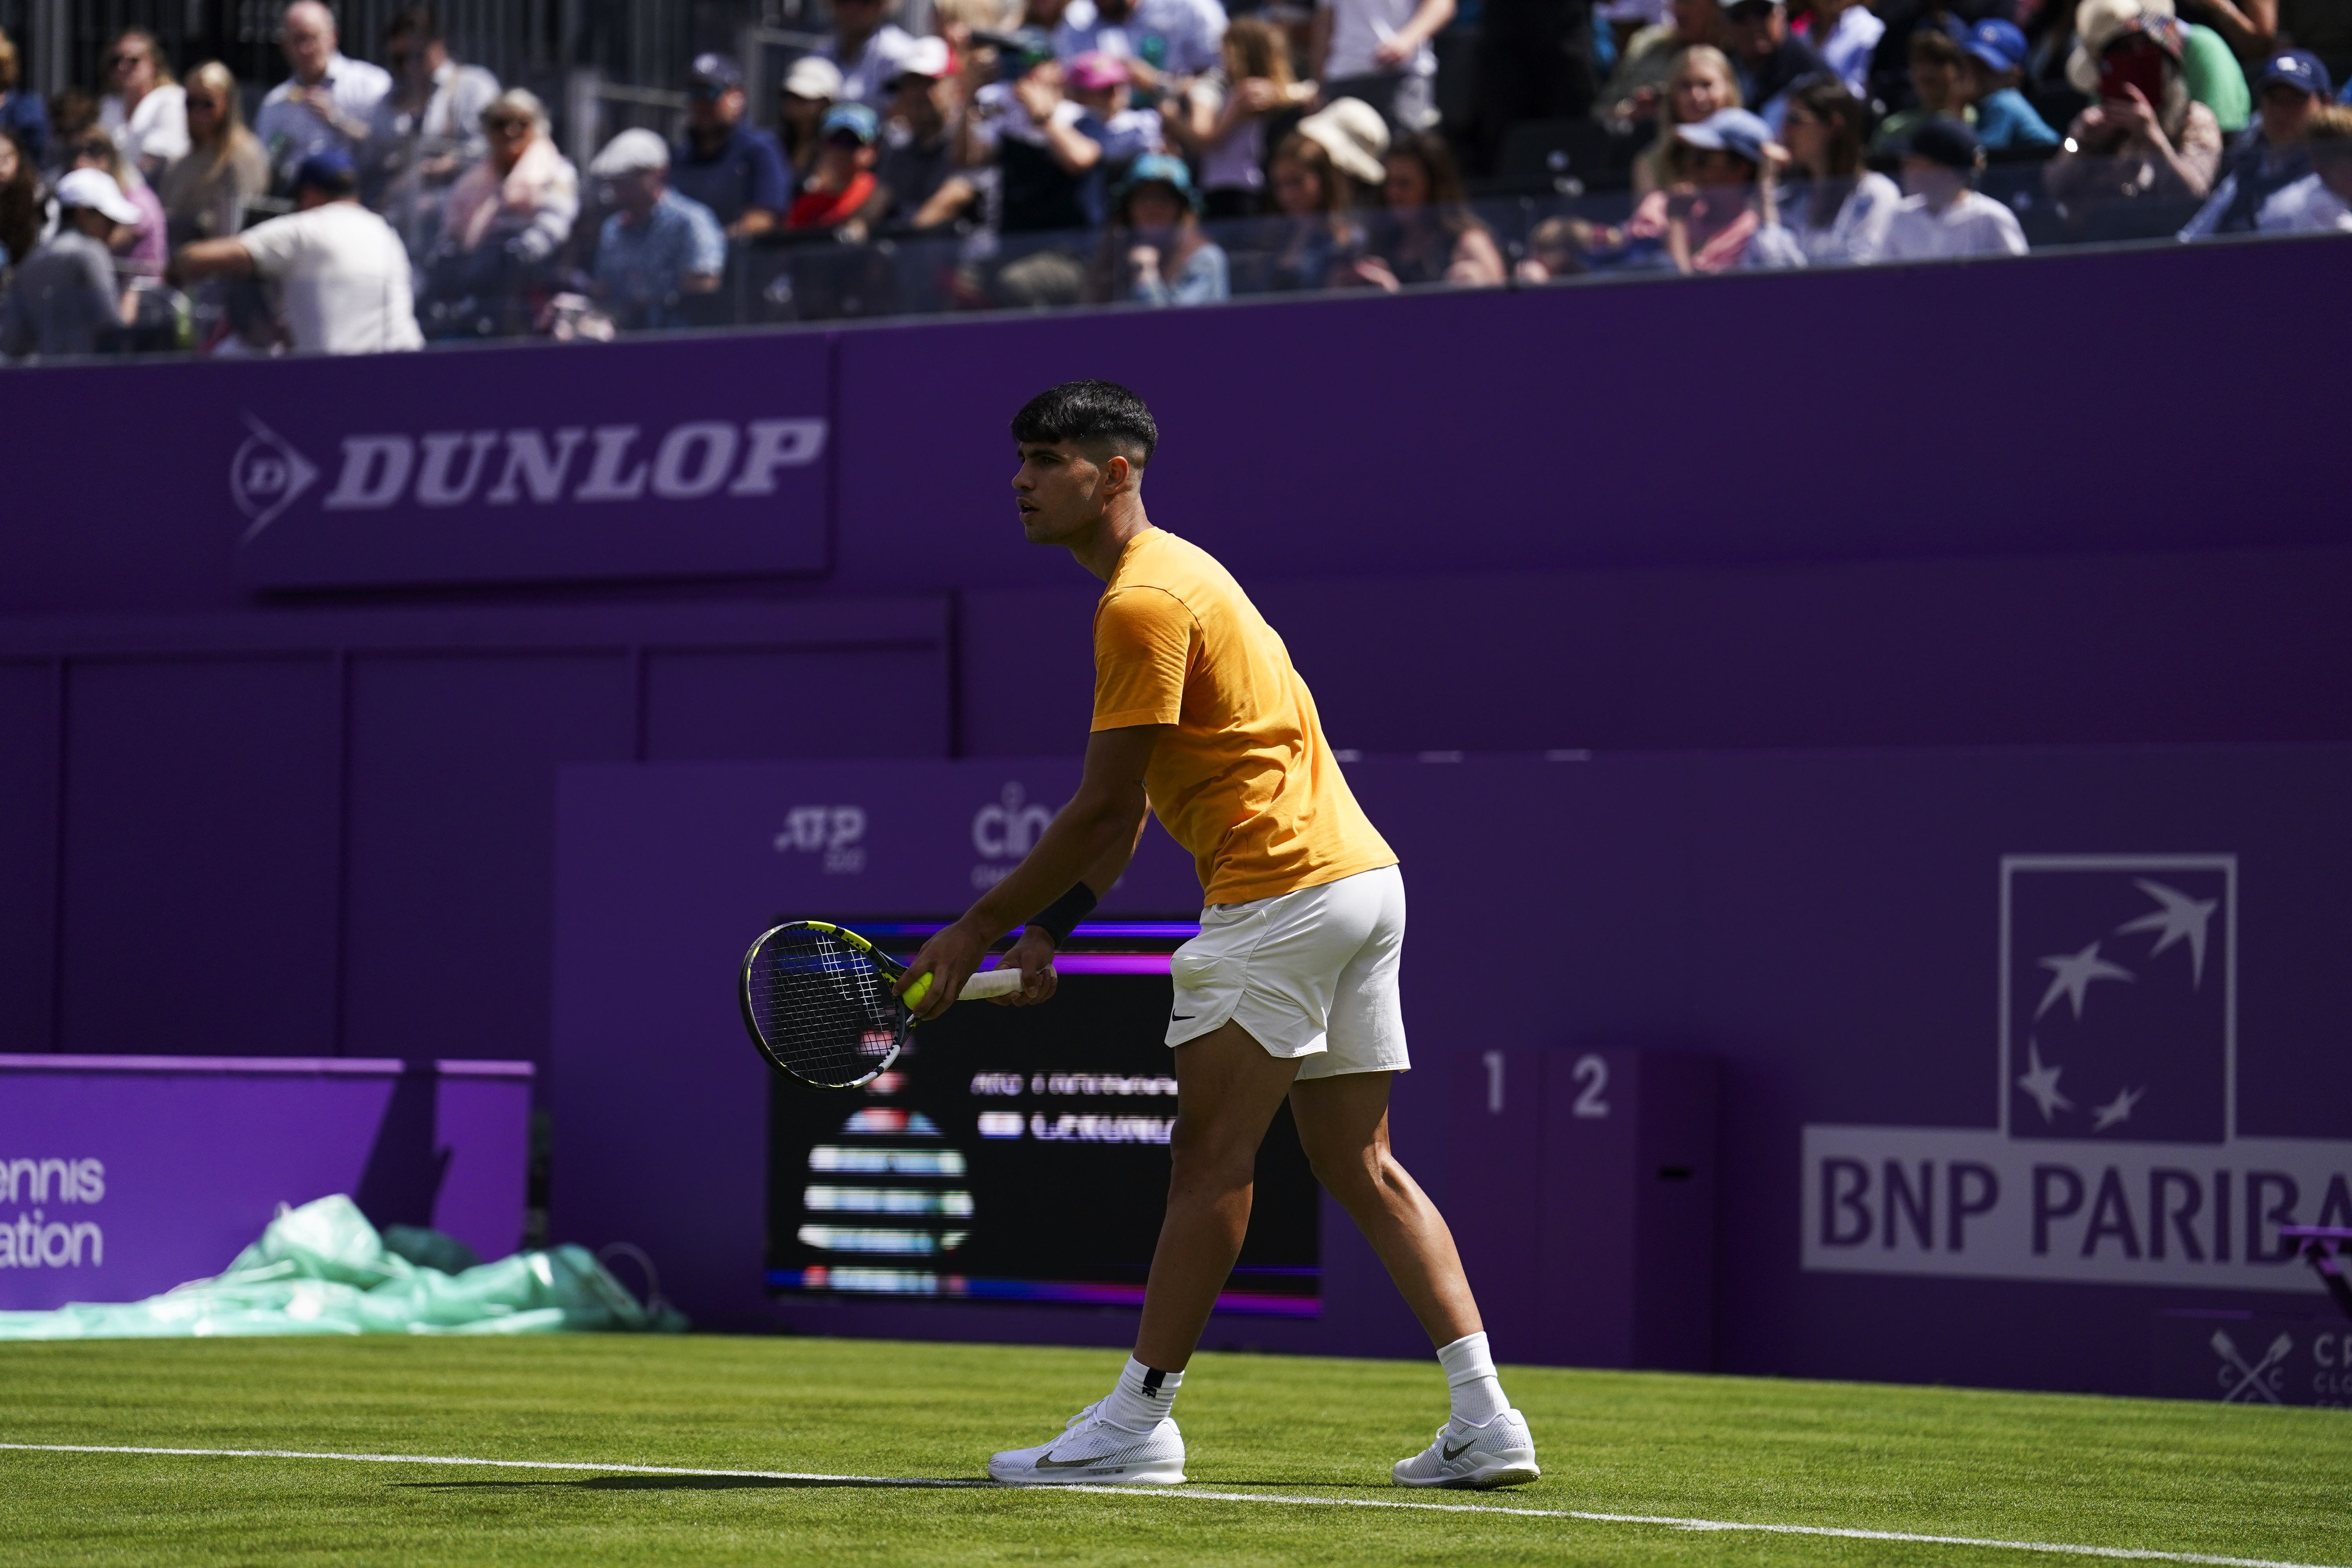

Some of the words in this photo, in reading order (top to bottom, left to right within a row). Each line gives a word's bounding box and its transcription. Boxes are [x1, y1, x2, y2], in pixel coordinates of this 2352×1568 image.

[322, 417, 828, 510] DUNLOP
[774, 806, 866, 852] ATP
[1483, 1051, 1504, 1113] 1
[1572, 1054, 1609, 1118] 2
[1820, 1156, 1999, 1252] BNP
